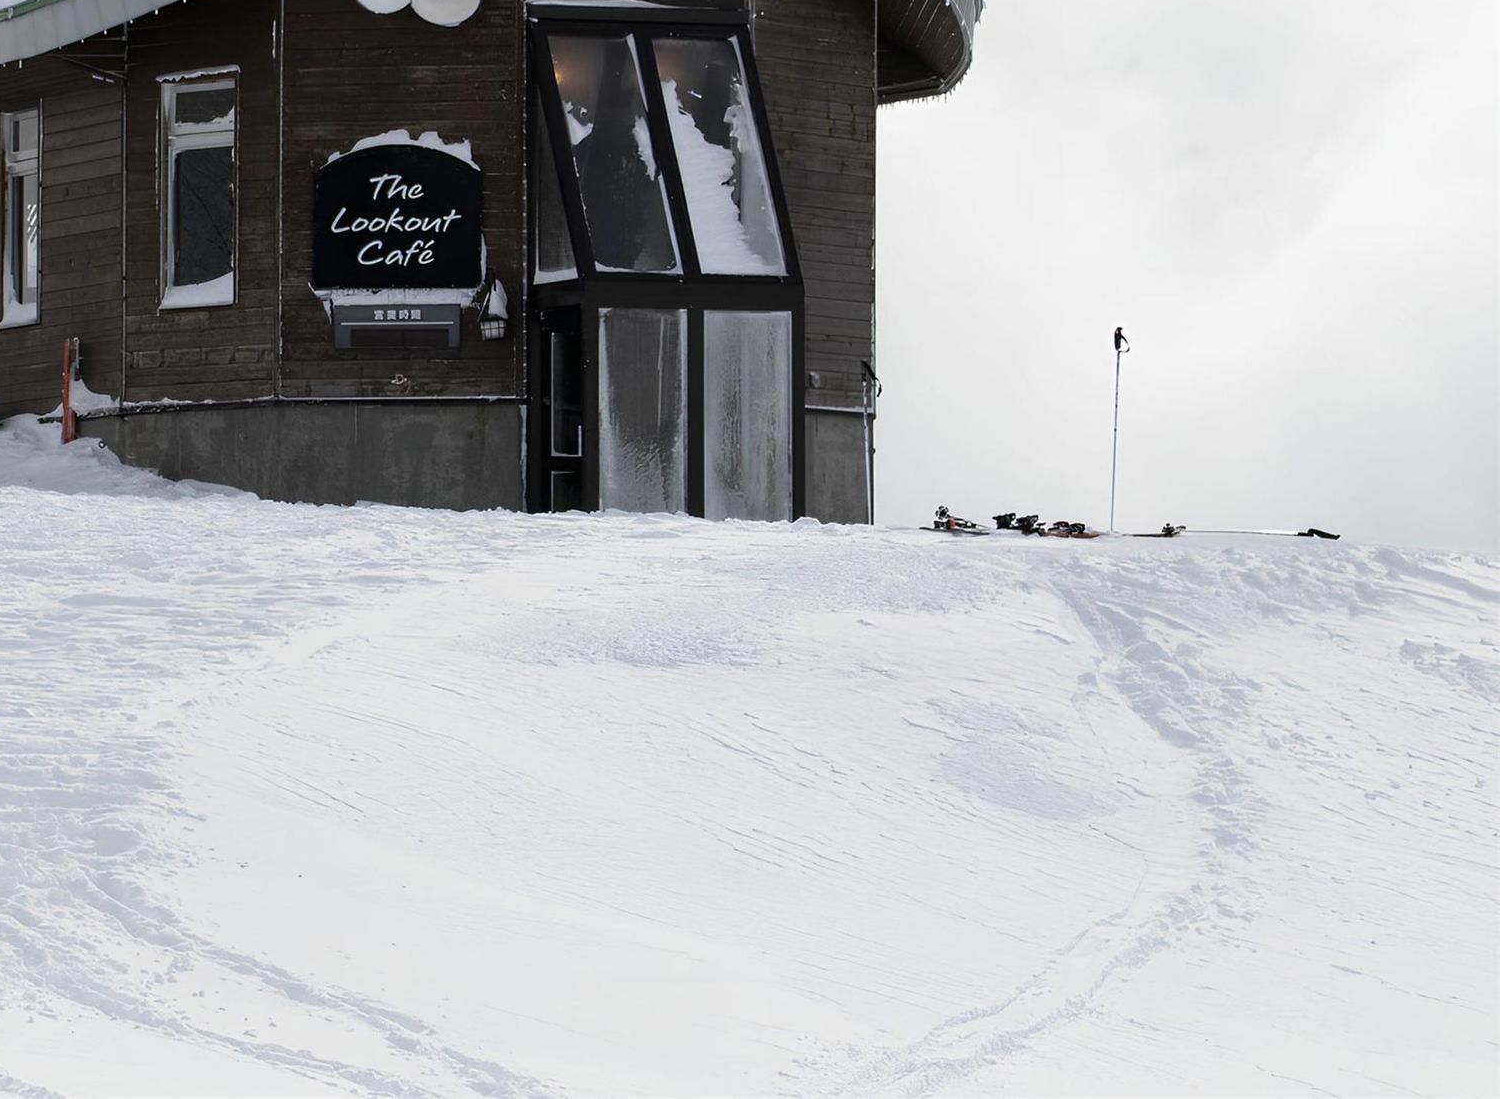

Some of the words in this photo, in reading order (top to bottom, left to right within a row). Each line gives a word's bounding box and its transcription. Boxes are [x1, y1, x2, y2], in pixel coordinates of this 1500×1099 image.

[369, 173, 424, 200] The
[330, 207, 462, 233] Lookout
[357, 239, 435, 267] Café
